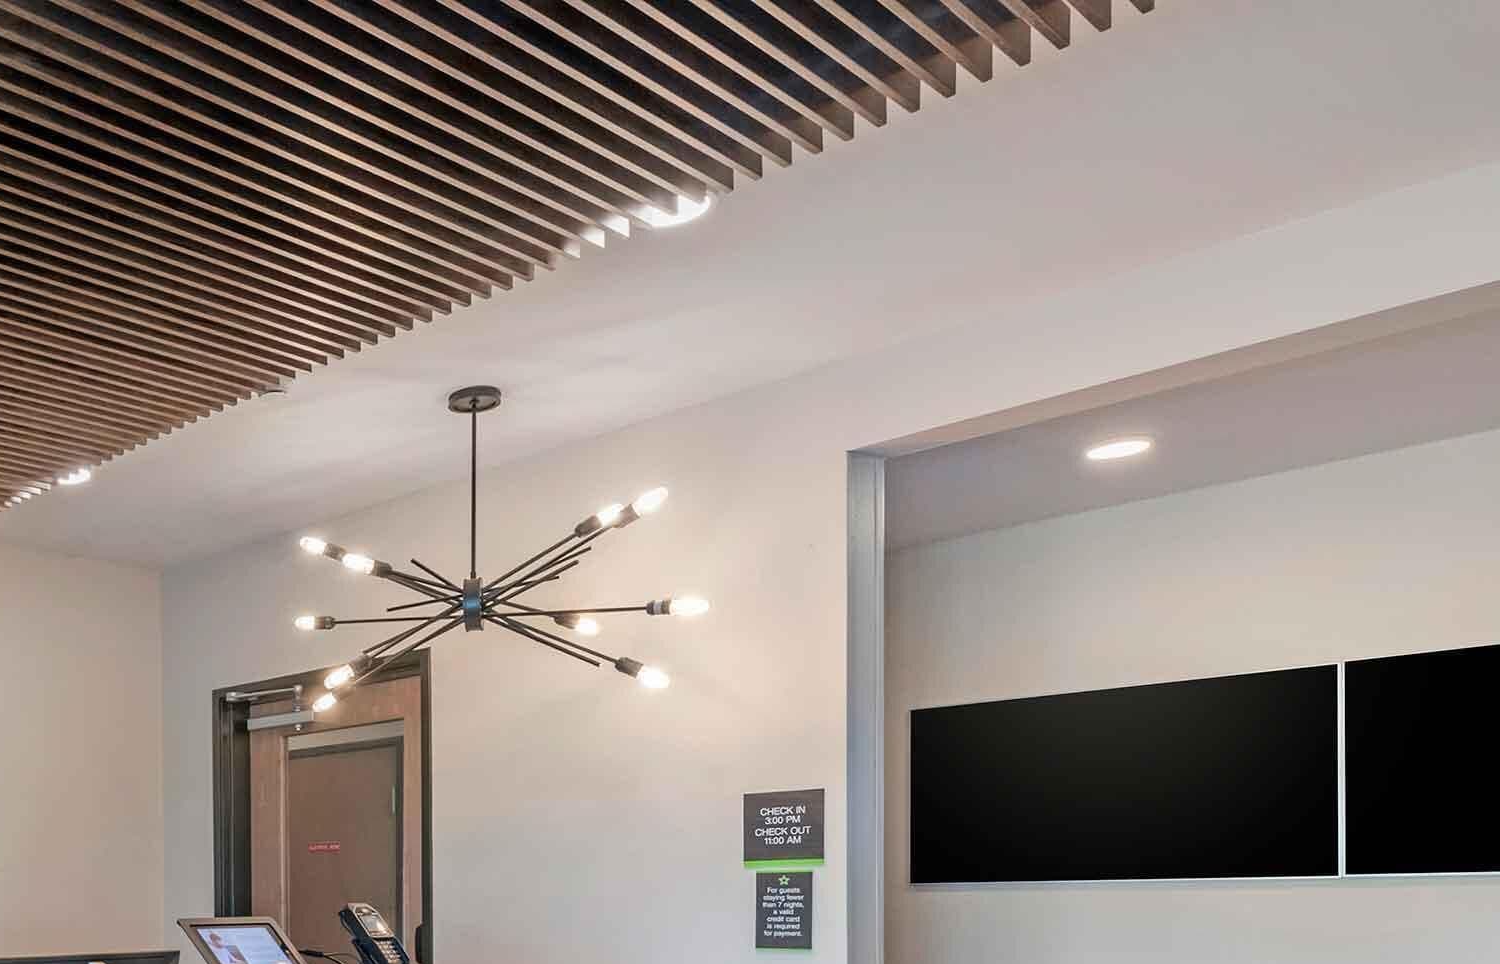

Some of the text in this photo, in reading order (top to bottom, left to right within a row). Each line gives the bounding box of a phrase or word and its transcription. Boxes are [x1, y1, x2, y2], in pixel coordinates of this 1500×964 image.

[760, 805, 806, 816] CHECK IN
[765, 815, 801, 825] 3:00 PM
[755, 826, 811, 836] CHECK OUT
[764, 836, 802, 845] 11:00 AM
